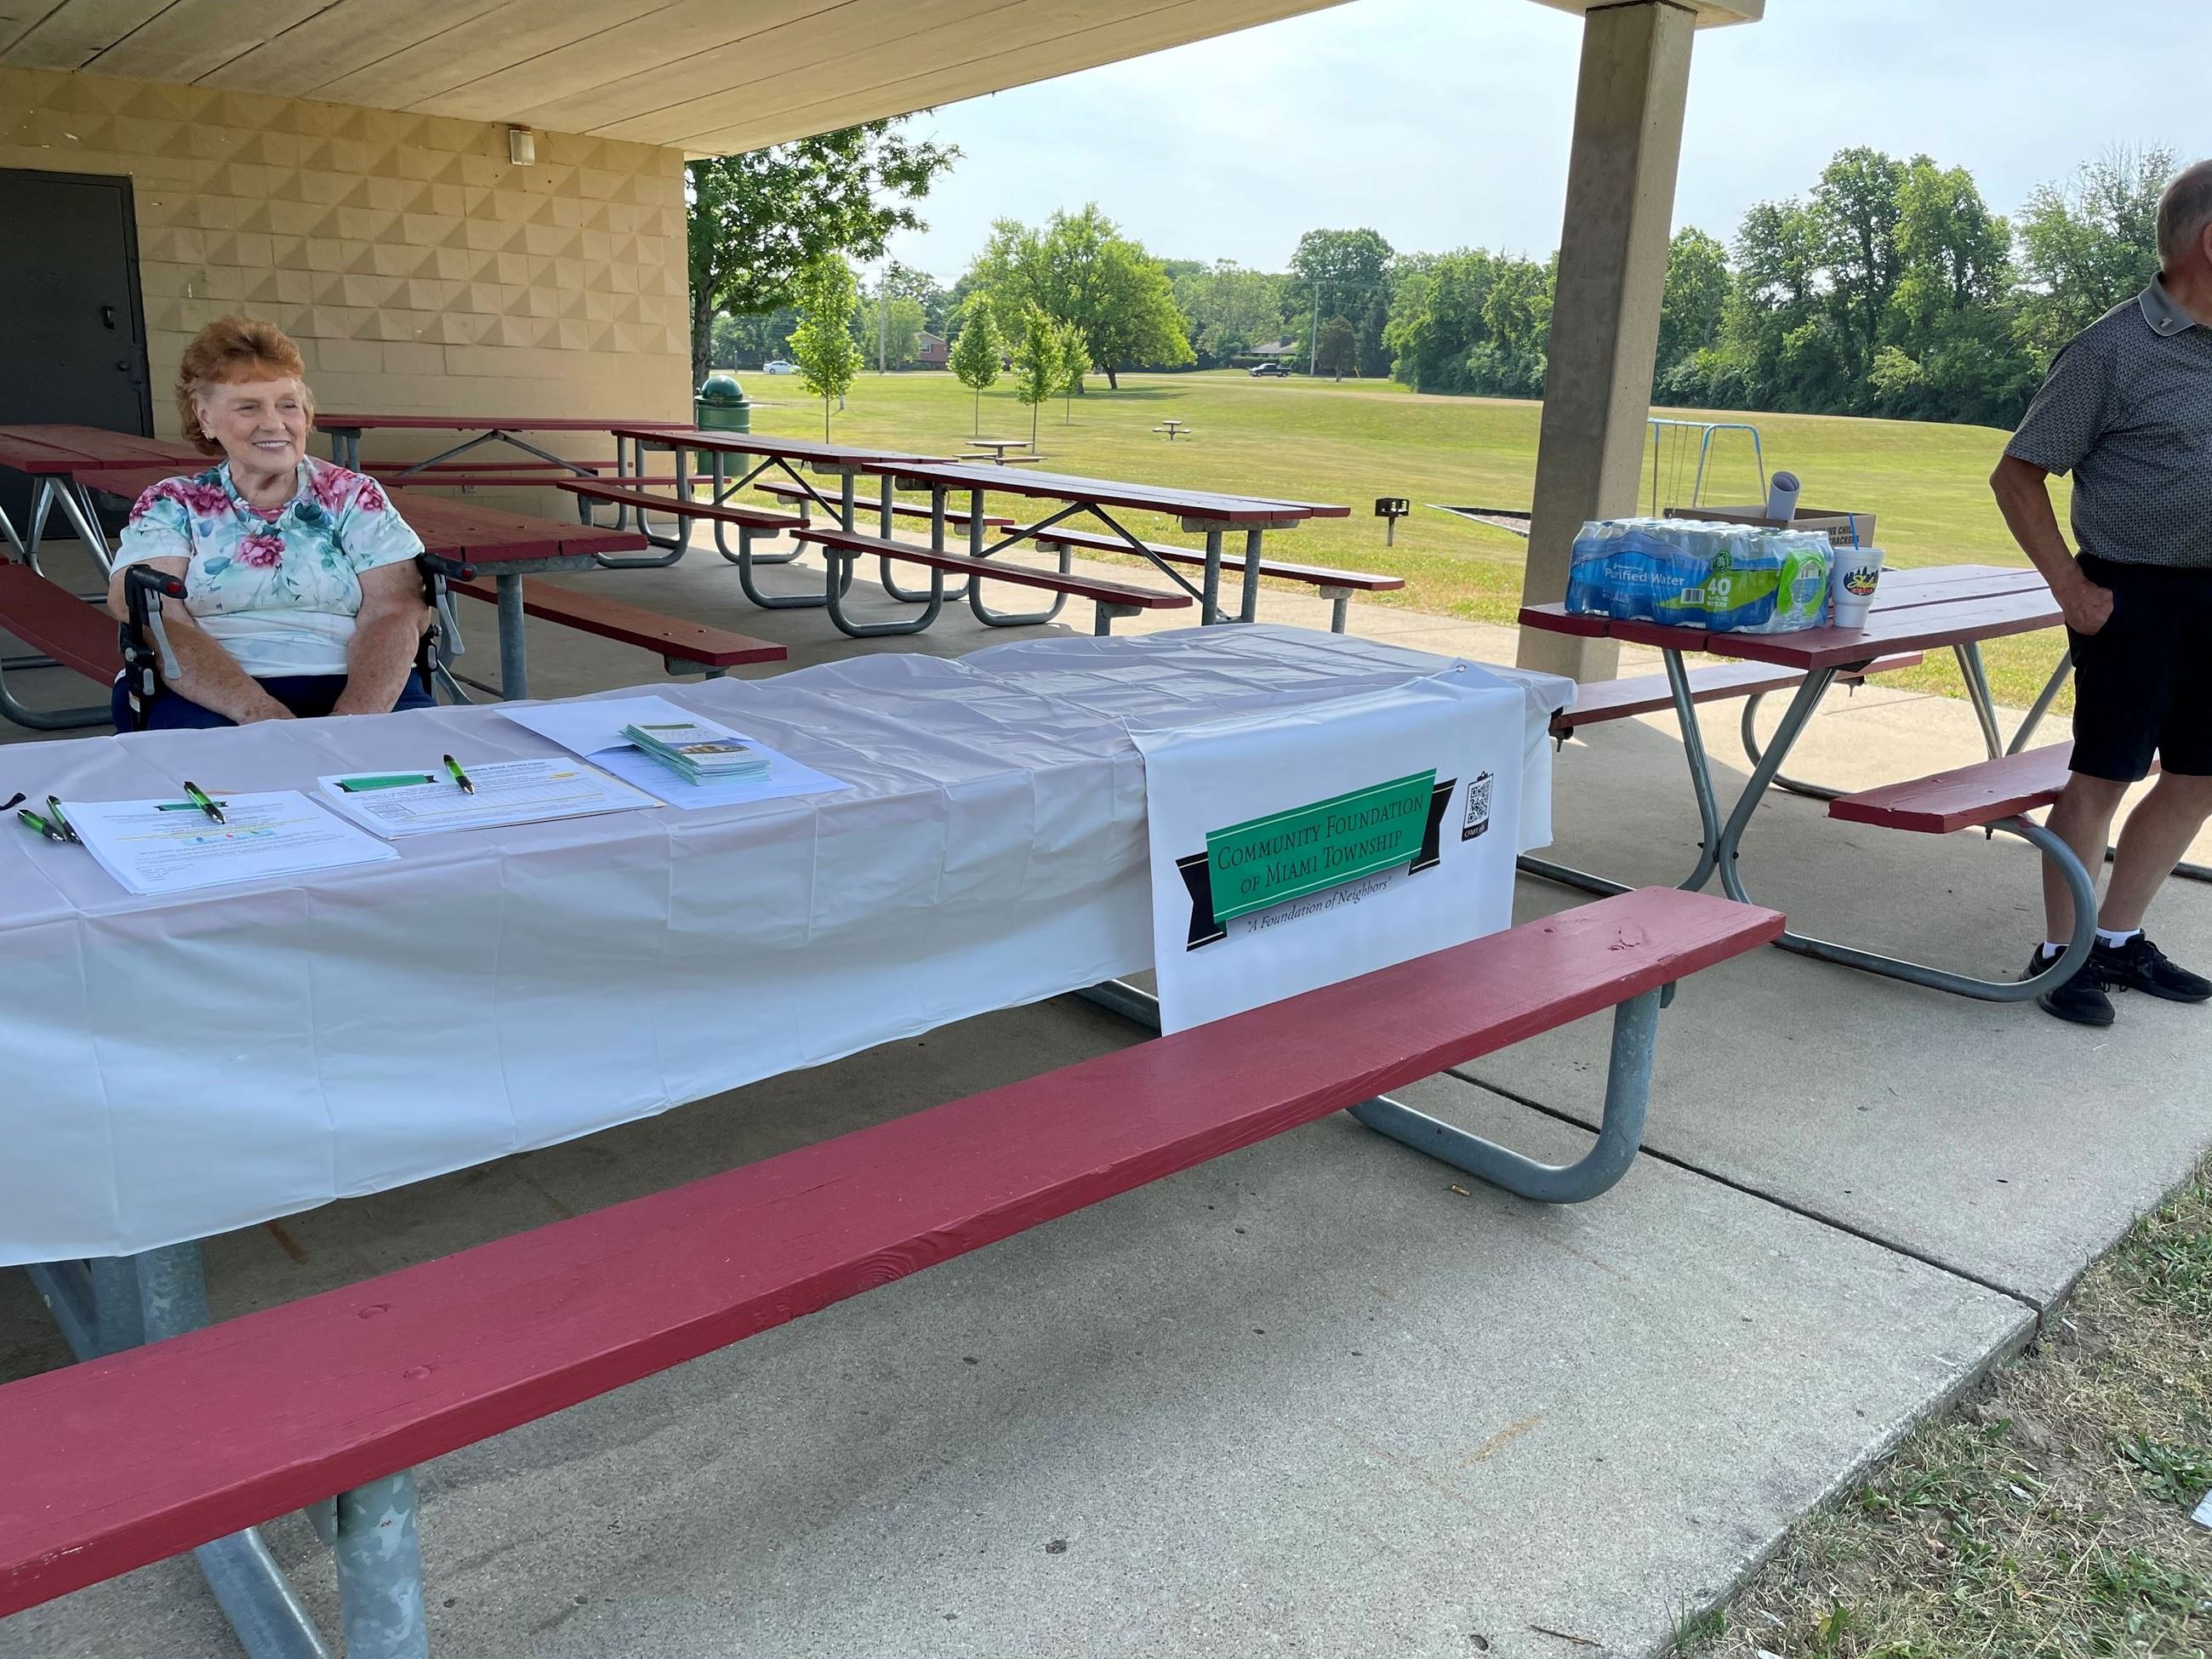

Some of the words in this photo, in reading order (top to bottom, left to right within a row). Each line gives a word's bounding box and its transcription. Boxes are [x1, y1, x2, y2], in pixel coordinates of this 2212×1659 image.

[1838, 525, 1852, 535] CHIL
[1605, 567, 1647, 582] Purified
[1650, 573, 1686, 586] Water
[1707, 578, 1731, 596] 40
[1217, 824, 1322, 870] COMMUNITY
[1326, 795, 1423, 838] FOUNDATION
[1240, 875, 1260, 894] OF
[1265, 855, 1318, 887] MIAMI
[1323, 830, 1403, 869] TOWNSHIP
[1247, 920, 1258, 932] "A
[1260, 901, 1323, 928] Foundation
[1325, 892, 1338, 910] of
[1337, 876, 1393, 904] Neighbors"
